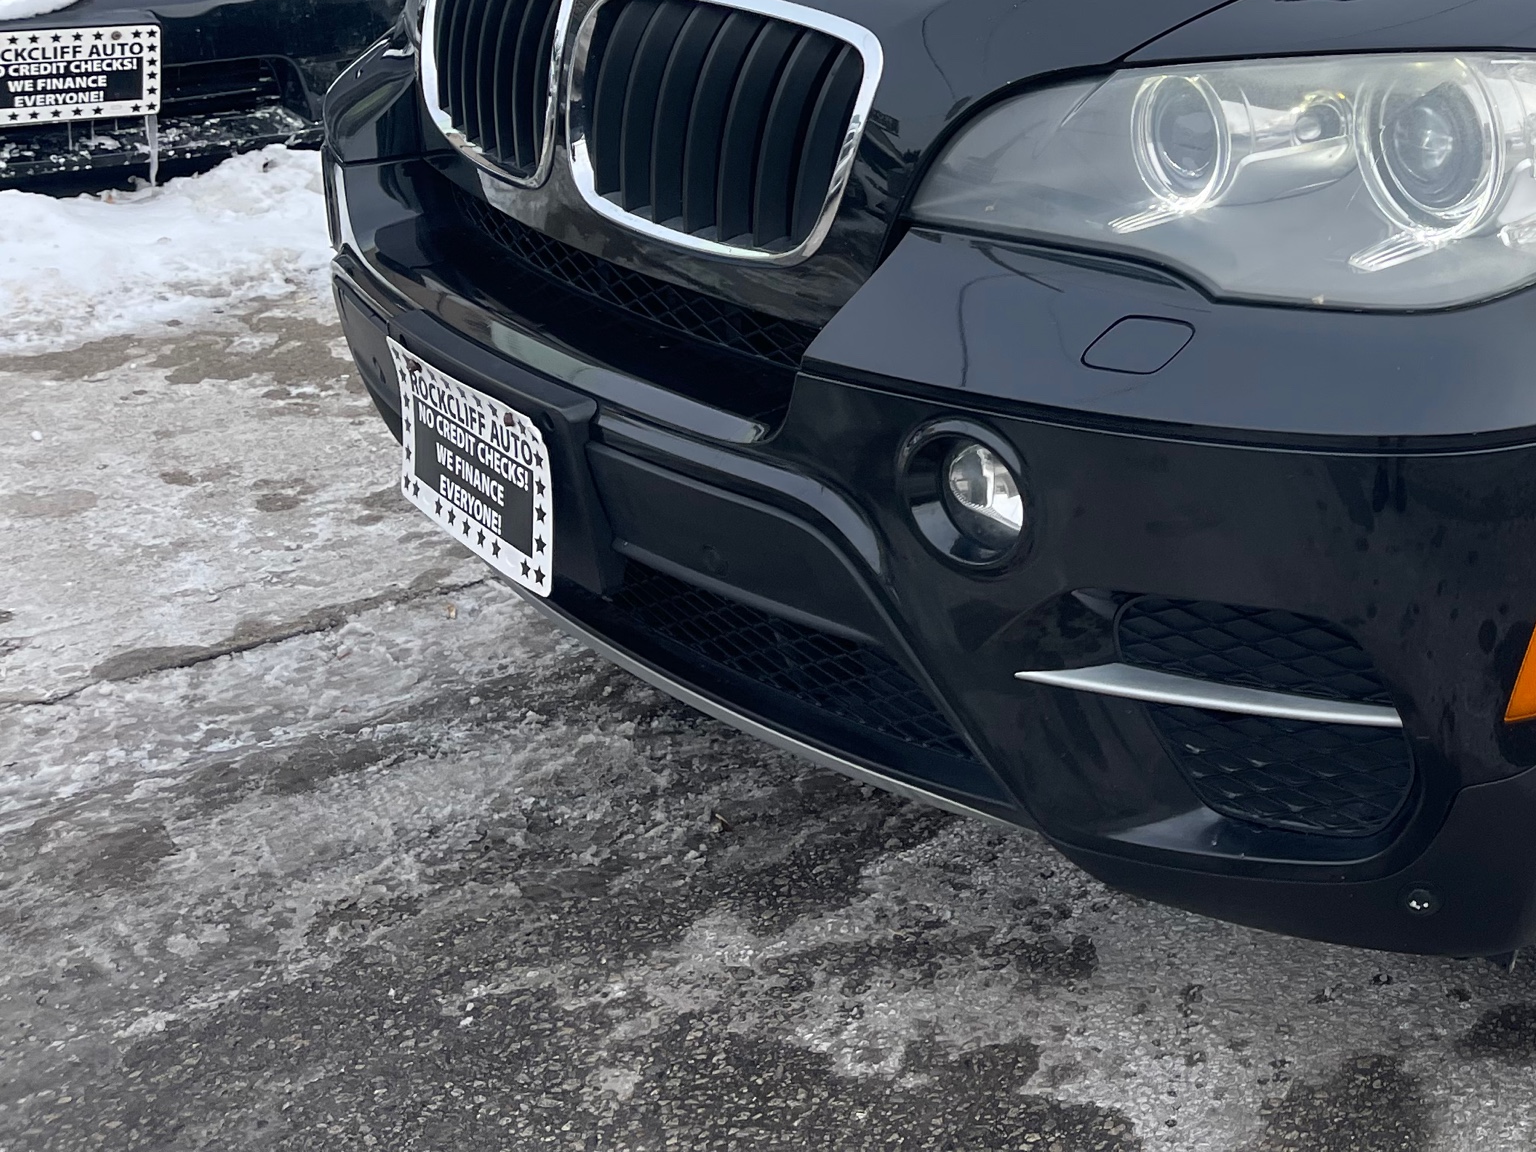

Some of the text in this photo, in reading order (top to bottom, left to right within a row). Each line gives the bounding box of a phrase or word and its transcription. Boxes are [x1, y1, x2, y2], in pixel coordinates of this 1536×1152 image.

[8, 62, 67, 76] CREDIT
[69, 58, 138, 71] CHECKS!
[88, 42, 144, 57] AUTO
[8, 75, 107, 92] WE FINANCE
[14, 91, 104, 107] EVERYONE!
[409, 369, 534, 466] ROCKCLIFF AUTO
[418, 404, 529, 491] NO CREDIT CHECKS!
[436, 442, 505, 507] WE FINANCE
[439, 474, 502, 535] EVERYONE!
